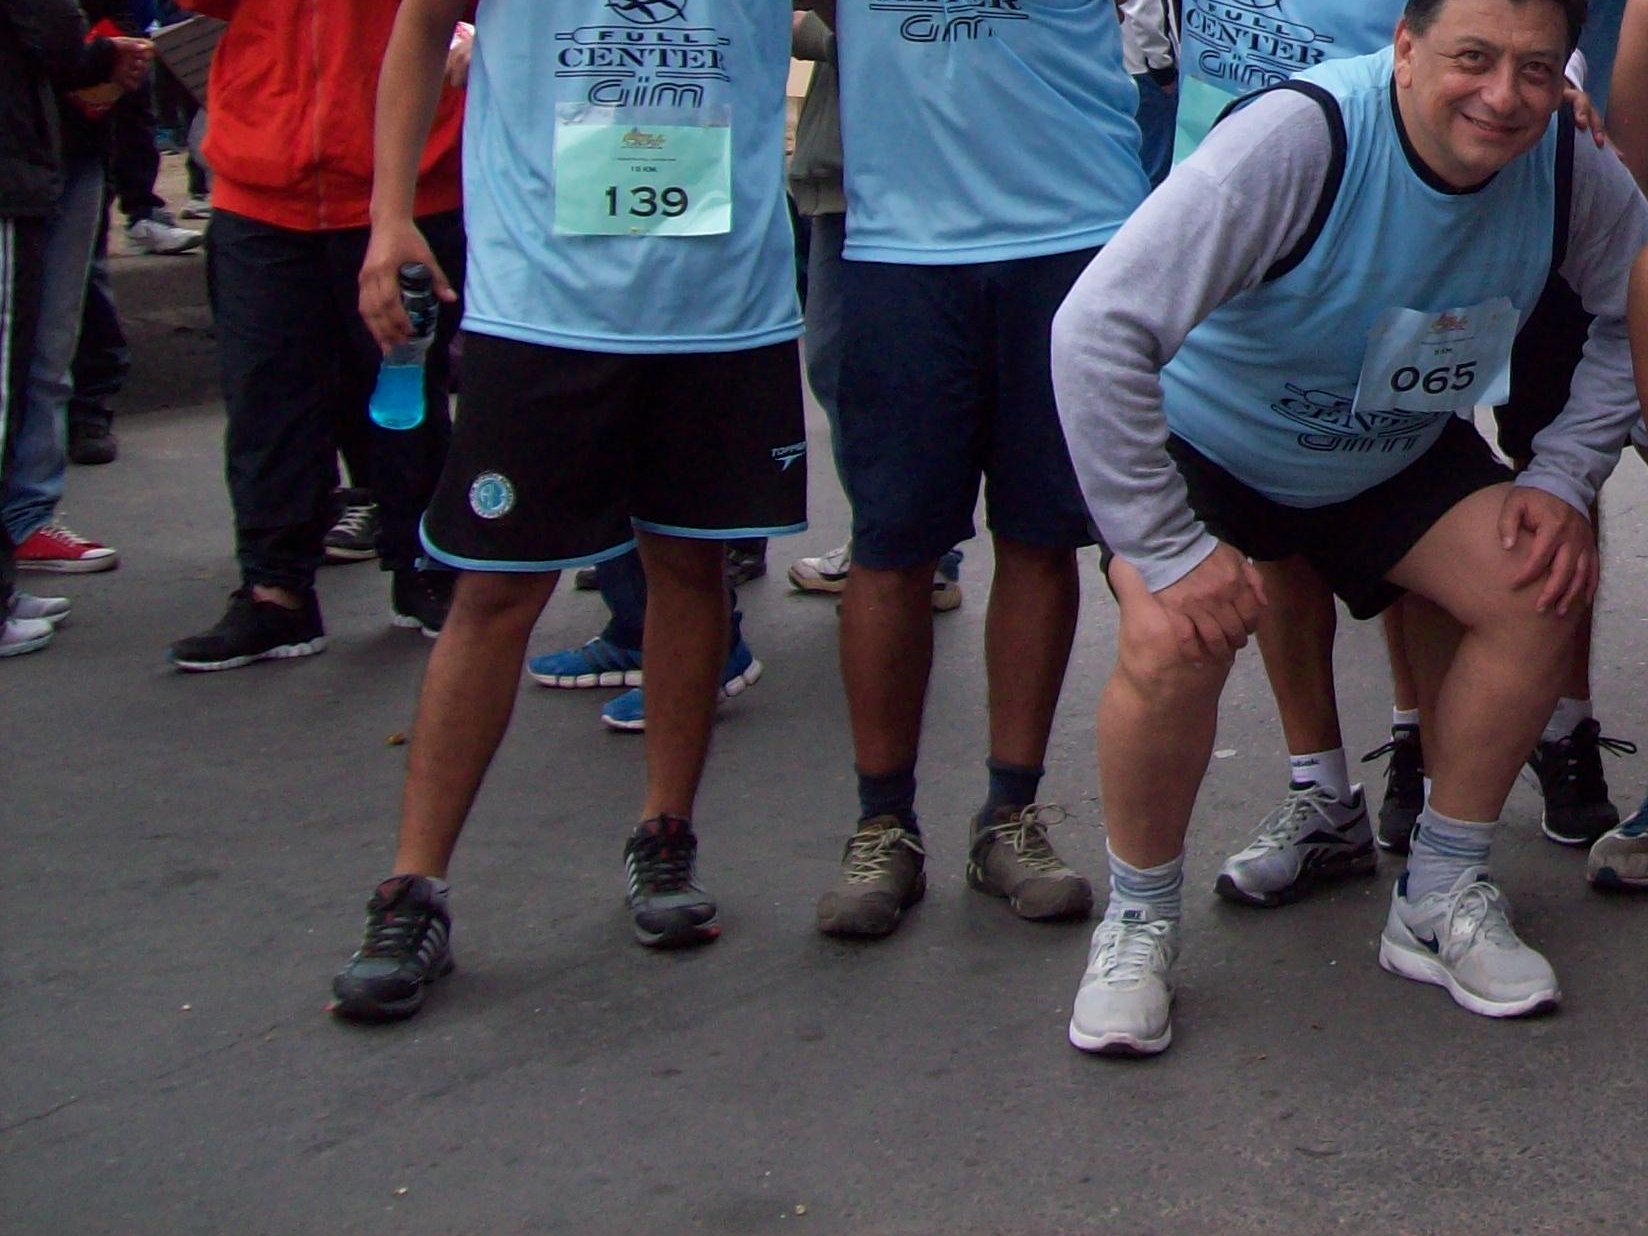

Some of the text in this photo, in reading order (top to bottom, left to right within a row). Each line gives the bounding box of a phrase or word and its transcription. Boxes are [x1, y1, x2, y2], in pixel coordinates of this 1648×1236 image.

[1207, 3, 1291, 36] FULL
[598, 30, 700, 43] FULL
[1186, 8, 1327, 65] CENTER
[557, 47, 727, 72] CENTER
[605, 186, 689, 218] 139
[1390, 361, 1478, 395] 065
